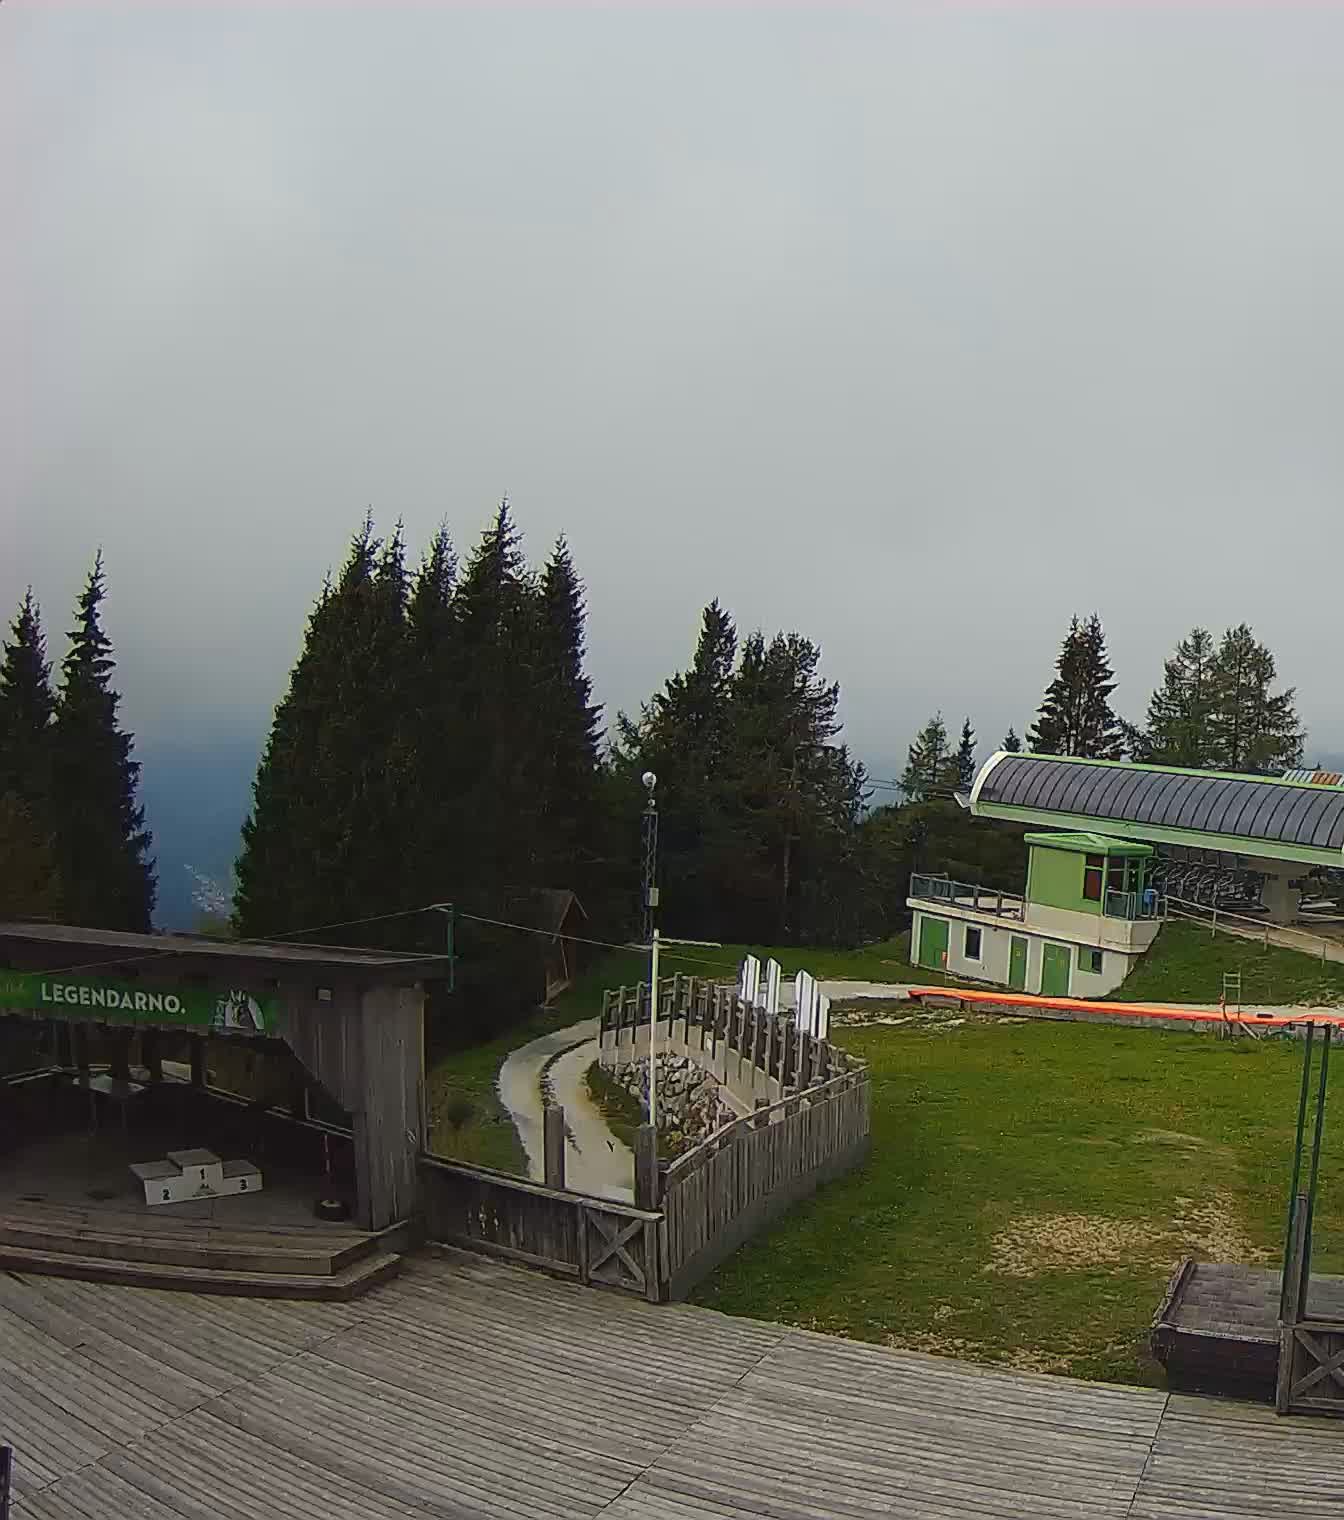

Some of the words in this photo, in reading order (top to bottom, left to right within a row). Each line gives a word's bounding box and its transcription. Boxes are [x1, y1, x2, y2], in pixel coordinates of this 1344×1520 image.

[41, 982, 186, 1014] LEGENDARNO.
[200, 1167, 205, 1179] 1
[240, 1179, 248, 1190] 3
[162, 1189, 170, 1200] 2
